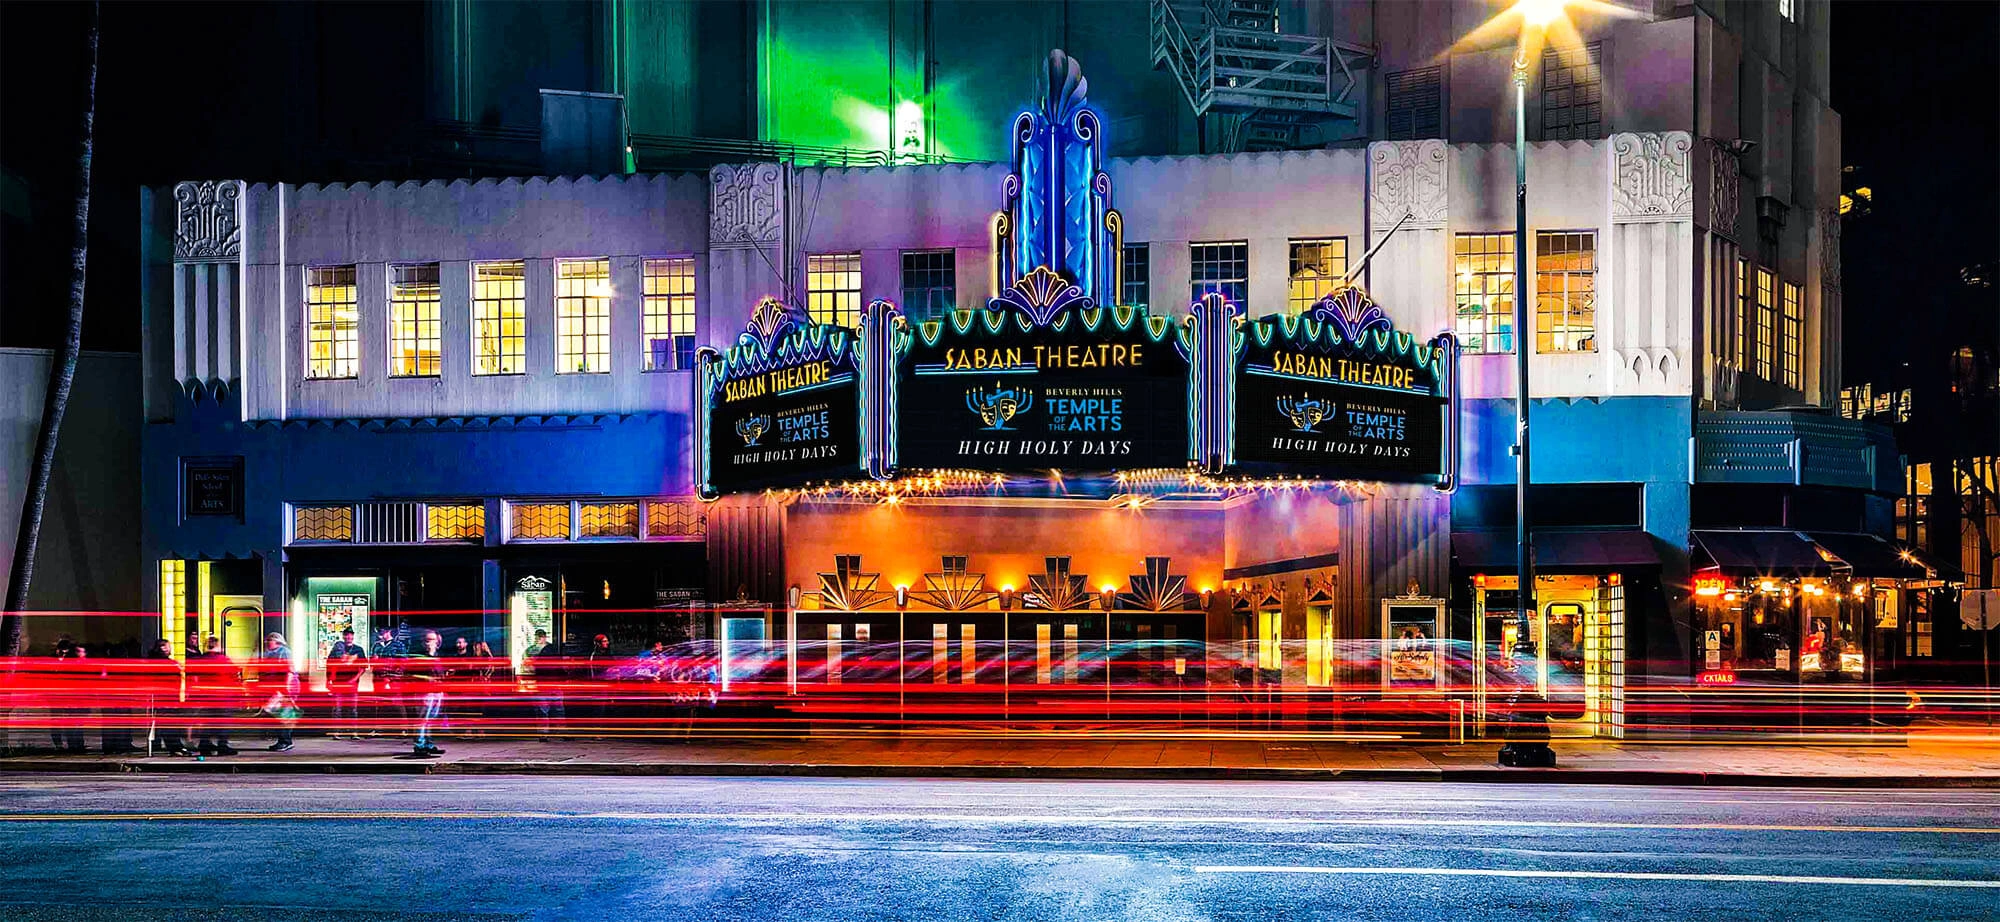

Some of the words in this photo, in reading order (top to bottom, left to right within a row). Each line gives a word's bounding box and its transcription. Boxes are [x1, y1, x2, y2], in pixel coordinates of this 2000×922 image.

[944, 347, 1021, 370] SABAN
[1033, 344, 1143, 369] THEATRE
[1273, 350, 1332, 378] SABAN
[1338, 359, 1414, 389] THEATRE
[725, 374, 766, 403] SABAN
[770, 360, 830, 393] THEATRE
[1046, 388, 1090, 396] BEVERLY
[1092, 388, 1122, 396] HILLS
[777, 407, 805, 417] BEVERLY
[807, 403, 829, 412] HILLS
[1045, 398, 1122, 415] TEMPLE
[1346, 402, 1381, 412] BEVERLY
[777, 411, 829, 430] TEMPLE
[1048, 423, 1066, 431] THE
[1053, 416, 1066, 424] OF
[1068, 415, 1122, 432] ARTS
[1345, 411, 1406, 429] TEMPLE
[792, 425, 829, 442] ARTS
[1363, 426, 1405, 441] ARTS
[733, 452, 760, 465] HIGH
[764, 448, 796, 463] HOLY
[801, 445, 837, 459] DAYS
[958, 440, 1011, 455] HIGH
[1019, 440, 1073, 455] HOLY
[1081, 440, 1132, 455] DAYS
[1272, 437, 1318, 451] HIGH
[1325, 441, 1368, 455] HOLY
[1373, 446, 1411, 458] DAYS
[1708, 631, 1717, 641] A
